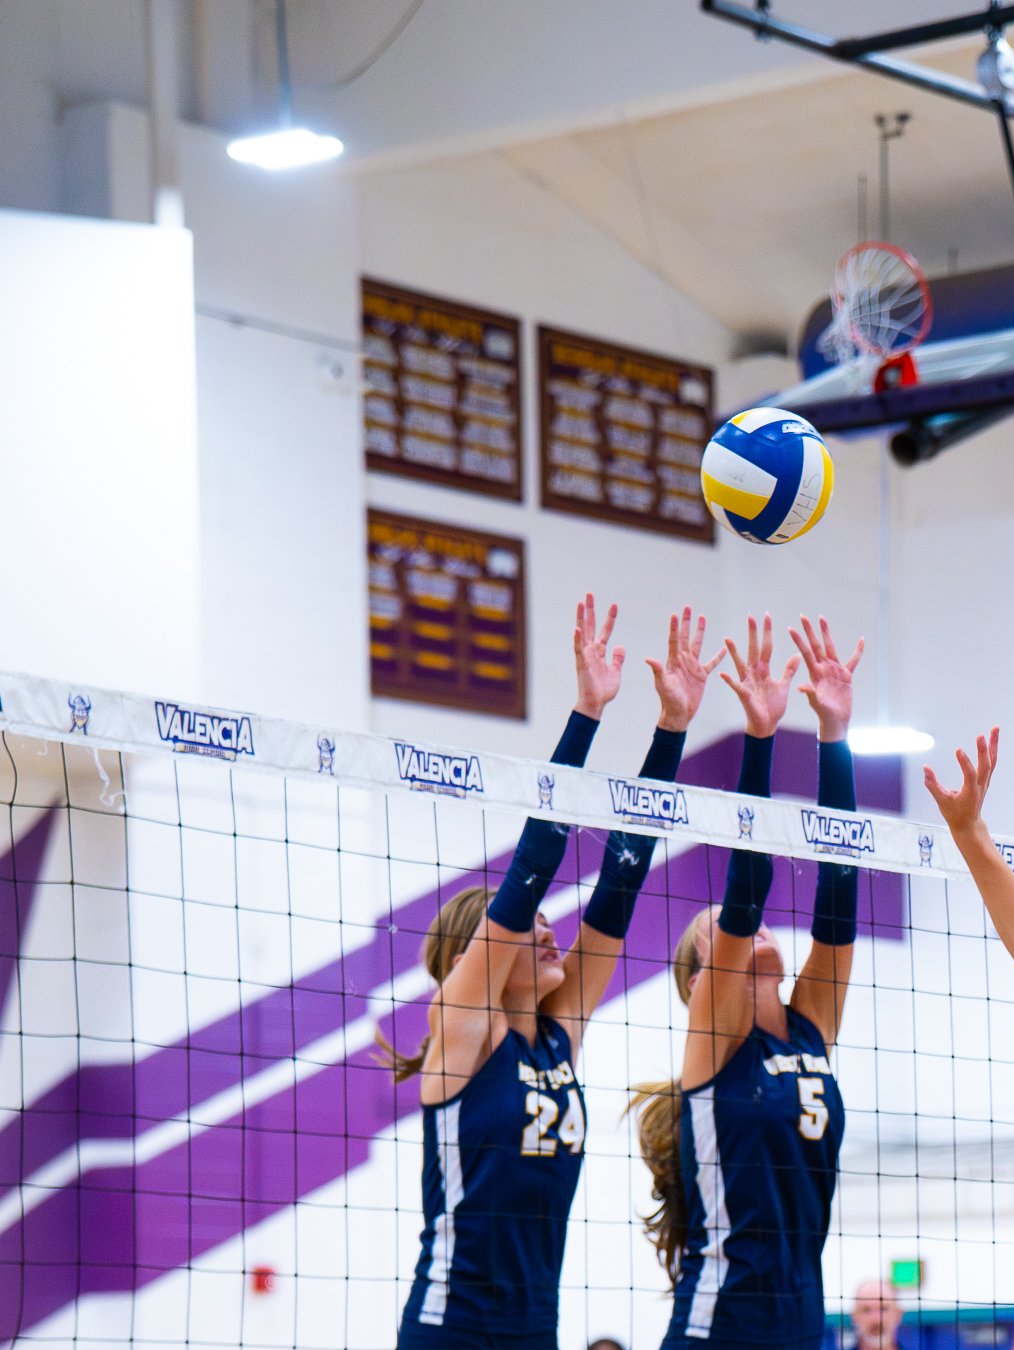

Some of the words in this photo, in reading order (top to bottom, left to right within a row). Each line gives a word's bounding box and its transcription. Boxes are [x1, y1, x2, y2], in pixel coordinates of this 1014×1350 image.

[155, 700, 255, 756] VALENCIA
[394, 742, 484, 793] VALENCIA
[608, 778, 689, 825] VALENCIA
[801, 809, 875, 853] VALENCIA
[520, 1087, 585, 1156] 24
[797, 1077, 829, 1140] 5
